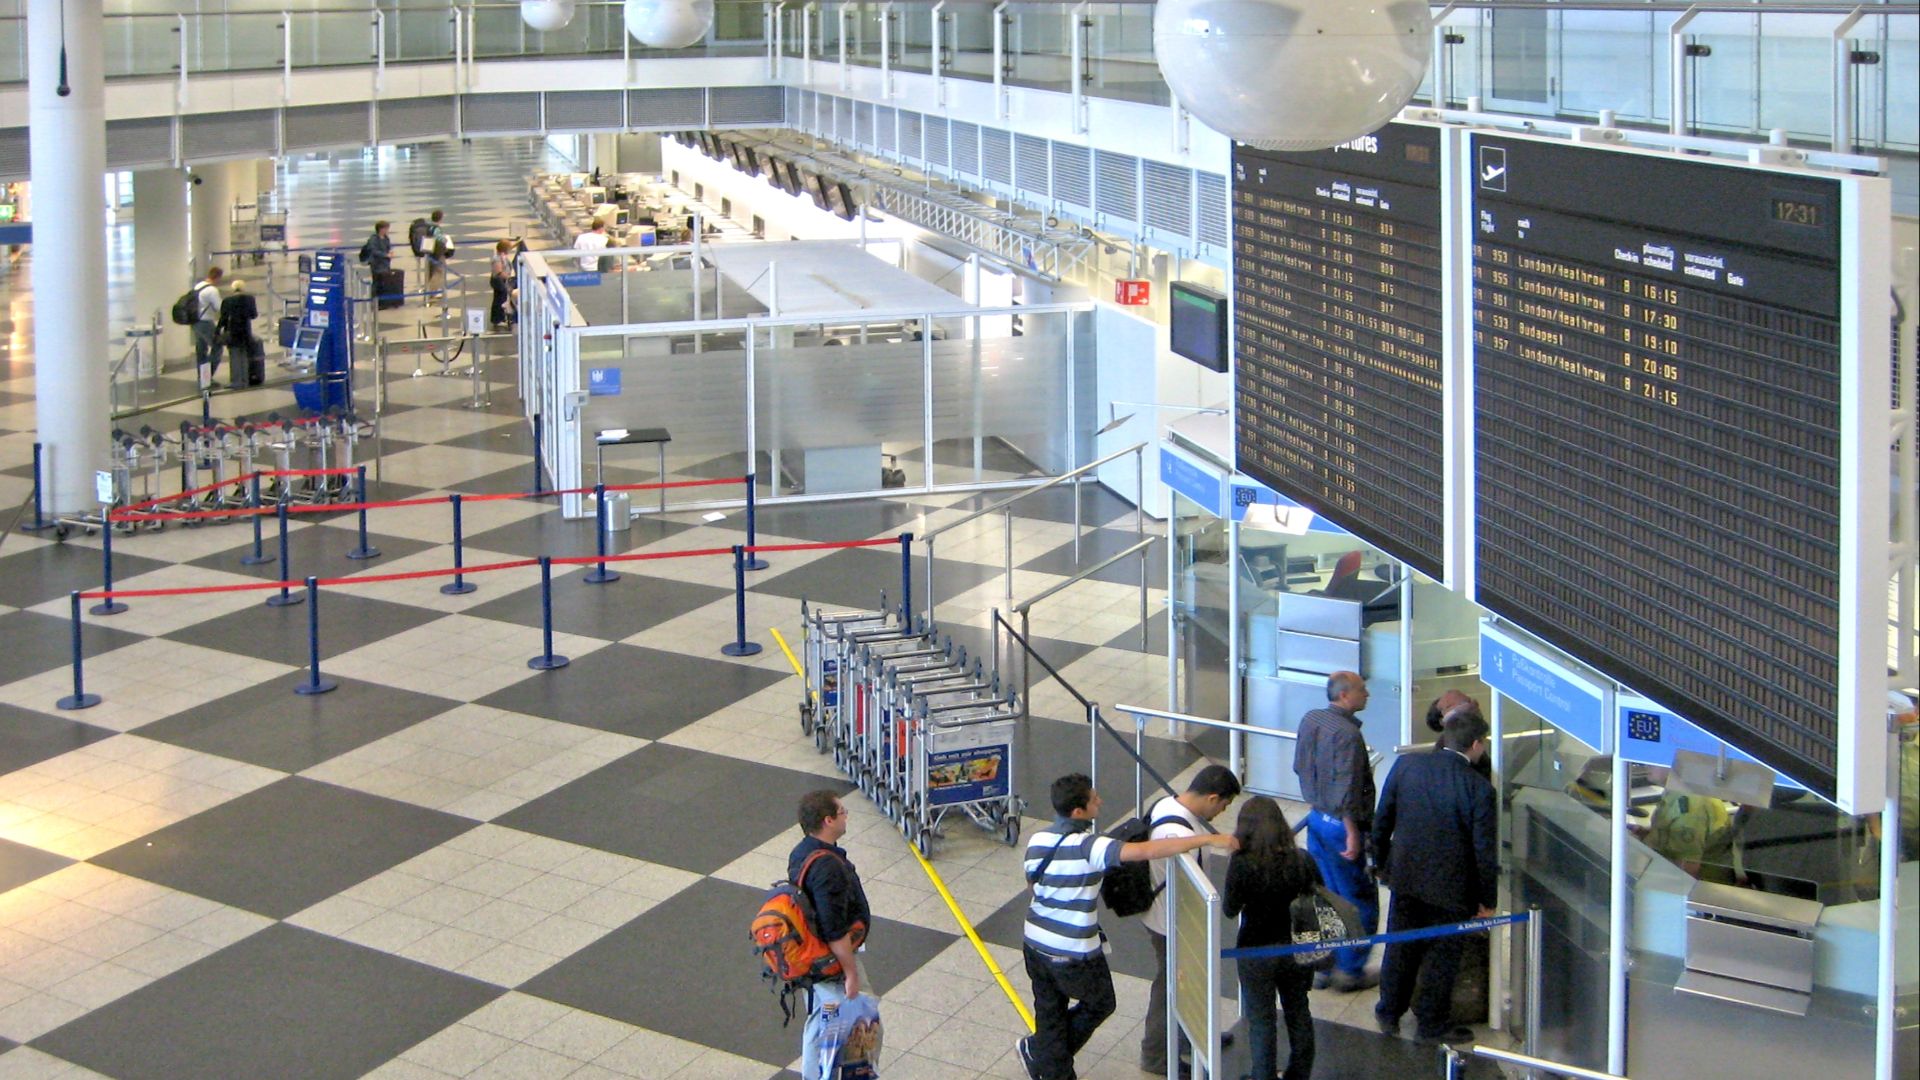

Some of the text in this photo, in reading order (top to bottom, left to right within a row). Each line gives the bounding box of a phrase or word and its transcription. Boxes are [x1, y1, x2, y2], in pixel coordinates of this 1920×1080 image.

[1518, 254, 1605, 287] London/Heathrow
[1644, 284, 1677, 304] 16:15
[1518, 276, 1605, 311] London/Heathrow
[1644, 308, 1677, 330] 17:30
[1518, 299, 1605, 335] London/Heathrow
[1644, 333, 1677, 355] 19:10
[1518, 321, 1564, 346] Budapest
[1644, 358, 1677, 380] 20:05
[1519, 344, 1606, 382] London/Heathrow
[1644, 383, 1677, 406] 21:15
[1241, 492, 1251, 503] EU
[1636, 720, 1652, 733] EU
[1323, 938, 1371, 949] Delta Air Lines
[1465, 922, 1483, 930] Delta
[1493, 917, 1512, 925] Lines
